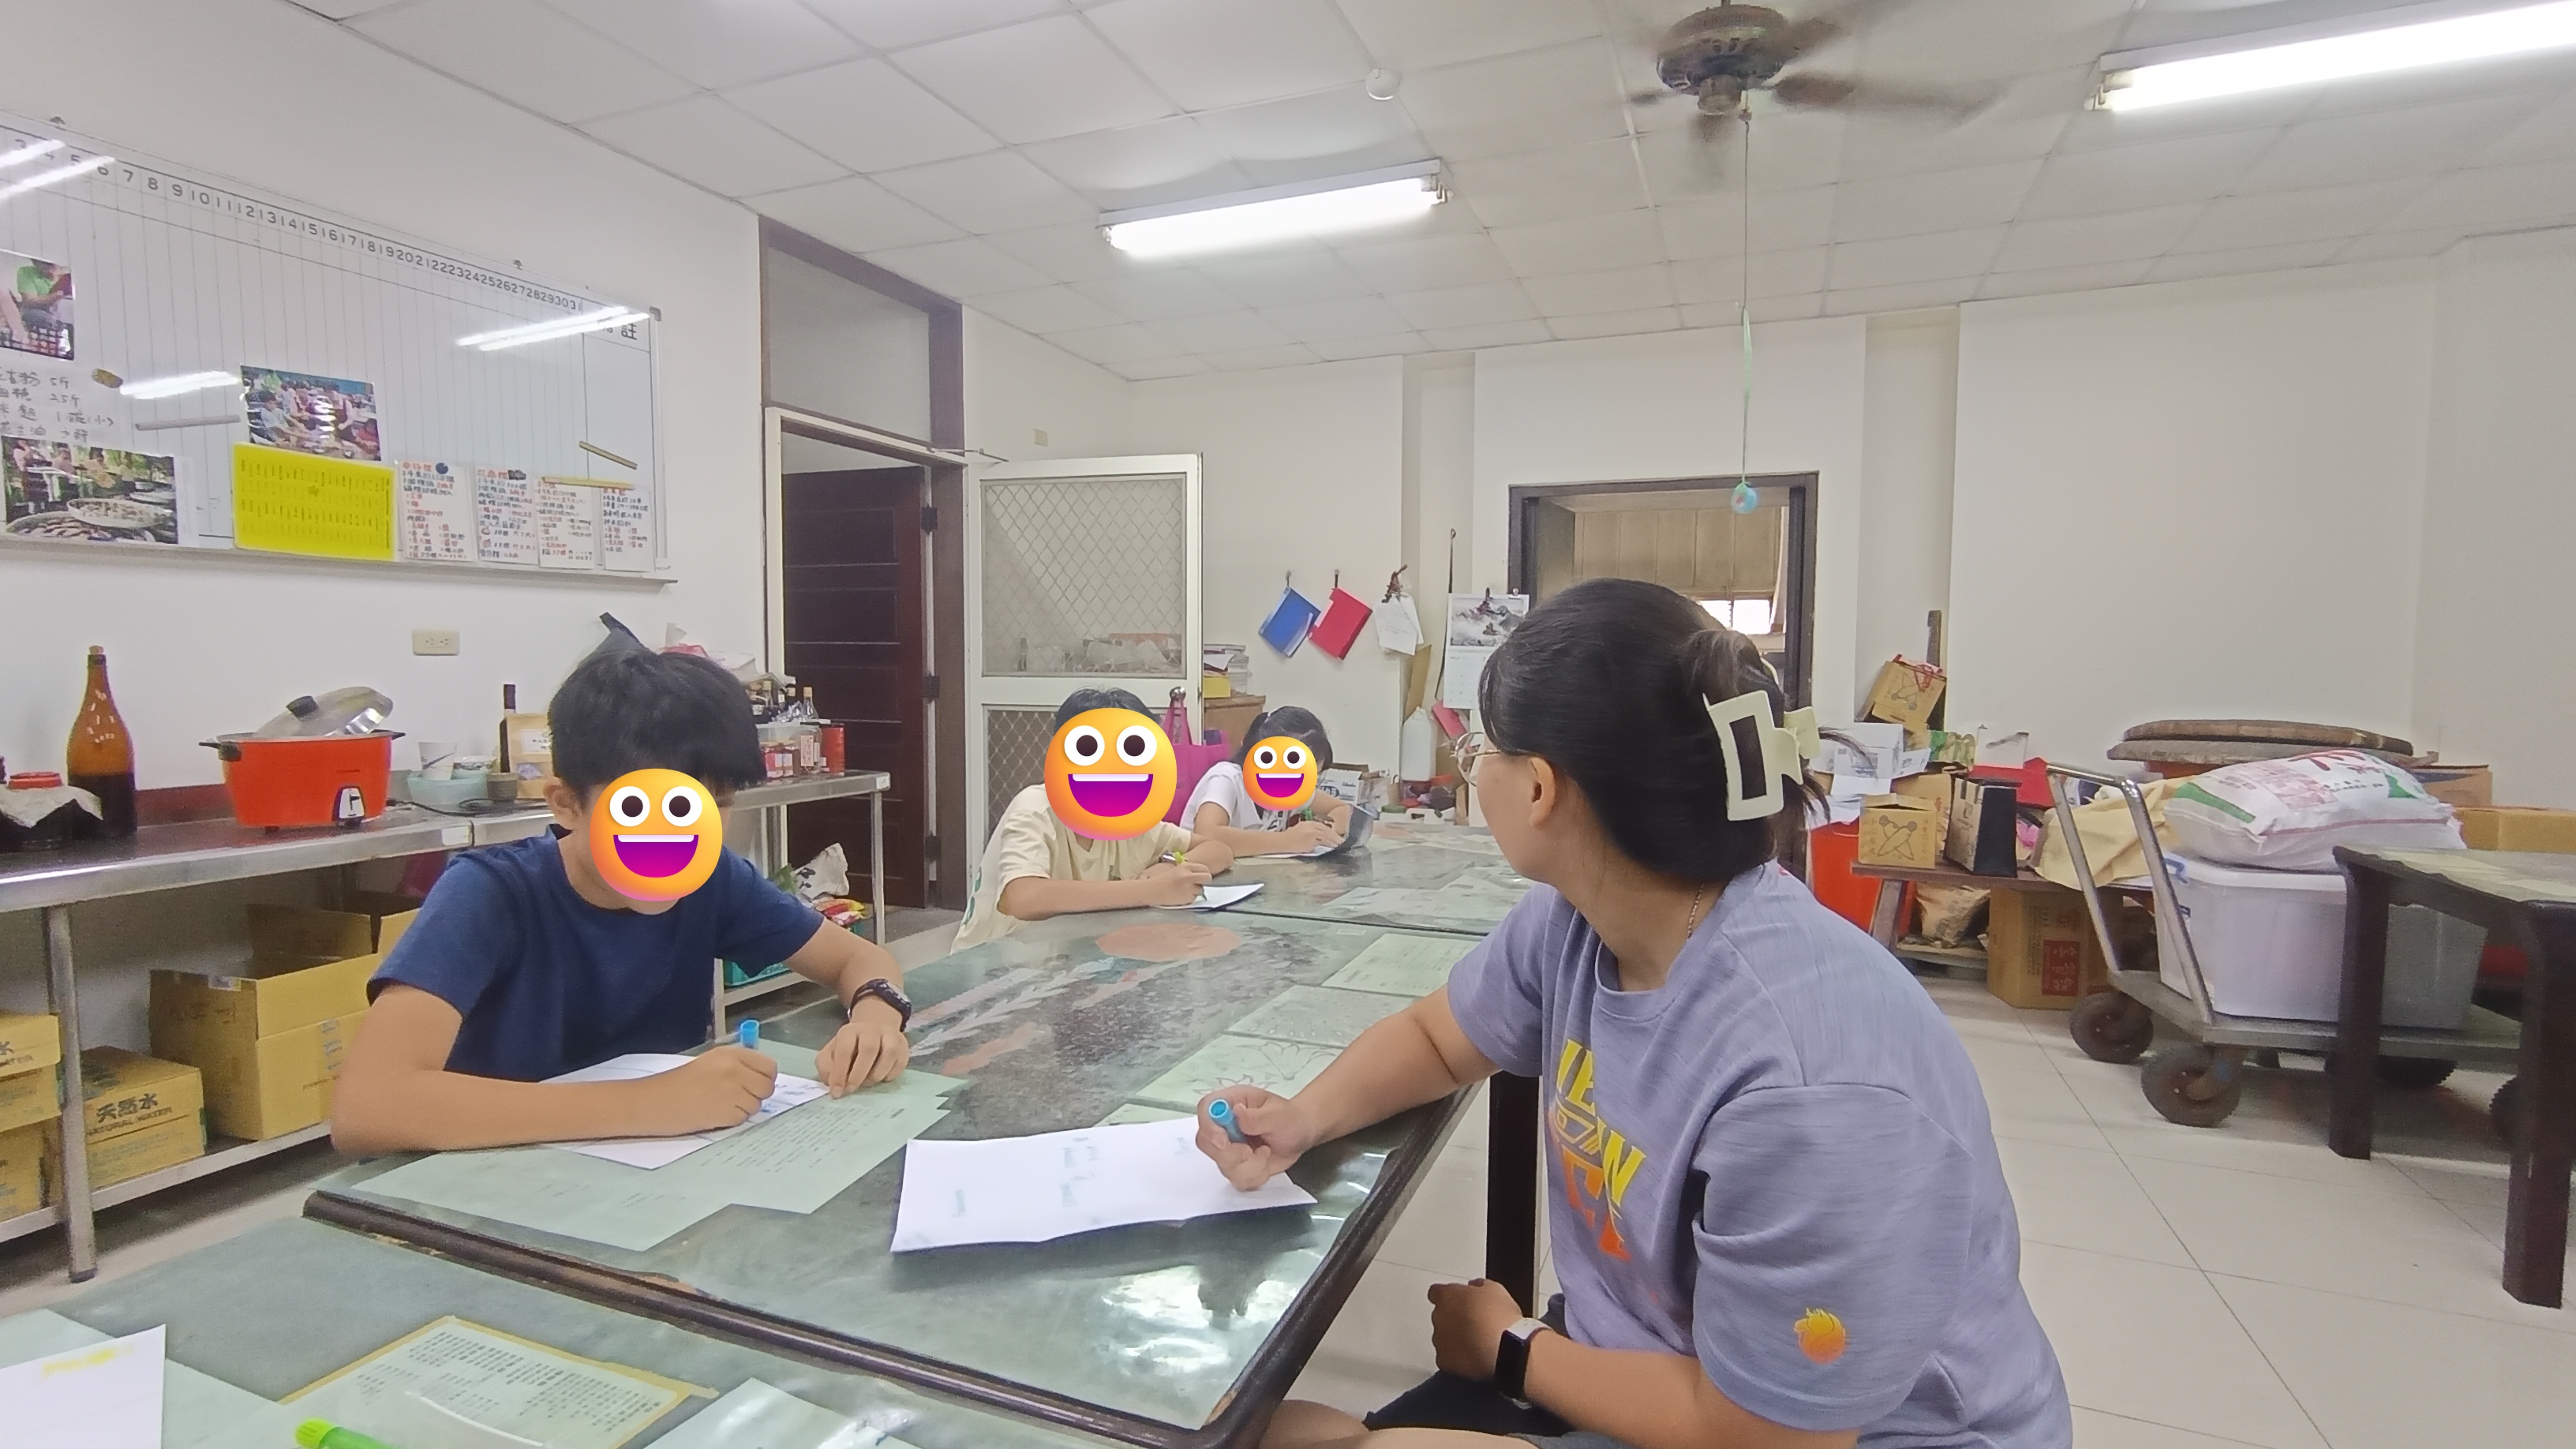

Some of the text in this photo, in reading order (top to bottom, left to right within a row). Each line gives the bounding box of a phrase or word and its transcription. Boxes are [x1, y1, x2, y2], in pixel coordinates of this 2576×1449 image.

[122, 169, 133, 182] 7
[148, 178, 159, 190] 8
[171, 184, 183, 197] 9
[191, 190, 210, 204] 10
[217, 197, 231, 212] 11
[238, 203, 255, 218] 12
[259, 209, 276, 224] 13
[281, 215, 298, 230] 14
[301, 222, 317, 235] 15
[321, 227, 339, 241] 16
[341, 233, 357, 246] 17
[361, 238, 376, 253] 18
[379, 244, 395, 257] 19
[396, 249, 414, 263] 20
[415, 255, 429, 268] 21
[431, 260, 447, 273] 22
[447, 264, 463, 277] 23
[464, 269, 480, 282] 24
[480, 274, 496, 286] 25
[496, 279, 511, 291] 26
[511, 283, 525, 295] 27
[526, 287, 540, 300] 28
[540, 292, 554, 304] 29
[554, 295, 568, 308] 30
[569, 300, 582, 312] 31
